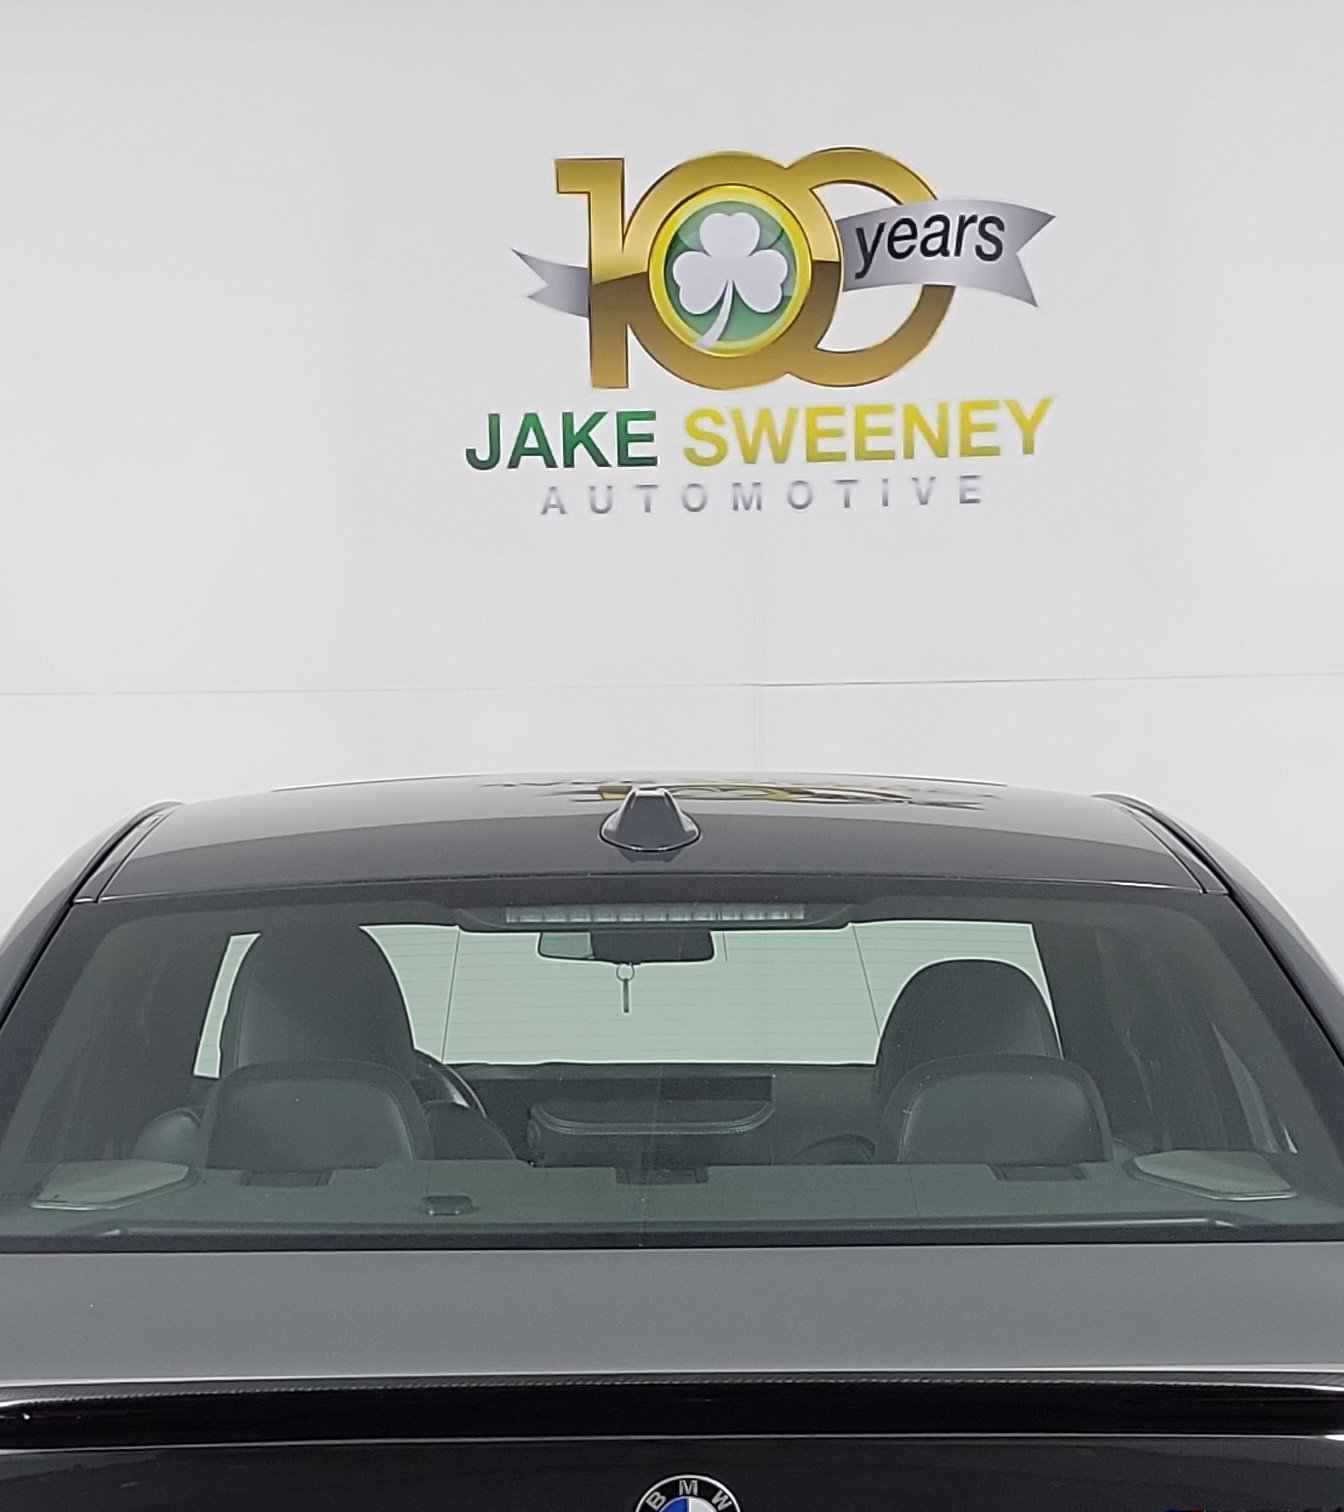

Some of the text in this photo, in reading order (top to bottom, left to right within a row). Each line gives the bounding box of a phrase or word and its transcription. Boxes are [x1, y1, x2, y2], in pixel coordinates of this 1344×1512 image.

[554, 146, 955, 390] 100
[855, 213, 1005, 279] years
[465, 397, 1055, 470] JAKE SWEENEY
[541, 475, 982, 515] AUTOMOTIVE
[645, 1480, 732, 1511] BMW
